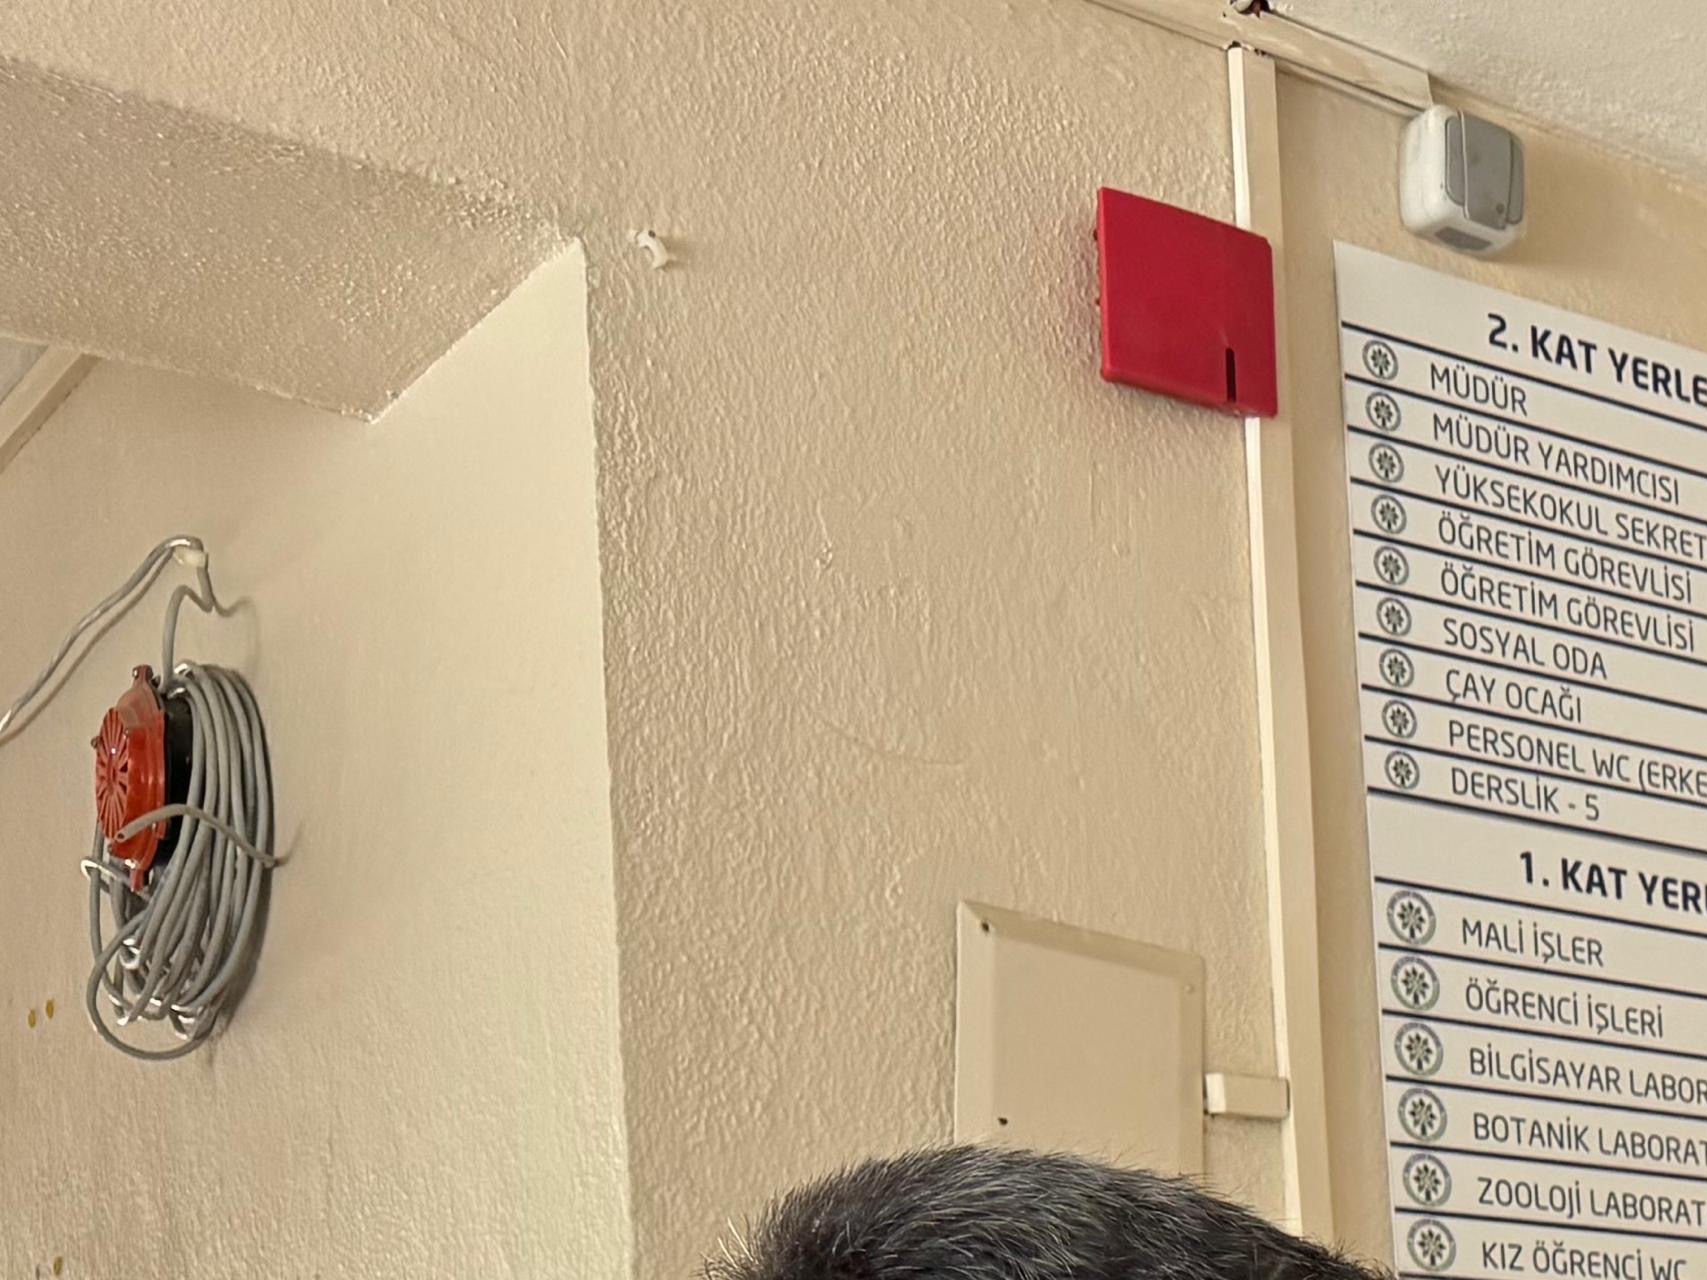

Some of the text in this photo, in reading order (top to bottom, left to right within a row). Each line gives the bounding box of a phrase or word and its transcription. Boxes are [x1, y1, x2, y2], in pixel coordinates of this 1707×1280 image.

[1488, 313, 1518, 352] 2.
[1531, 325, 1597, 374] KAT
[1430, 362, 1526, 415] MÜDÜR
[1433, 415, 1679, 505] MÜDÜR YARDIMCISI
[1435, 466, 1609, 536] YÜKSEKOKUL
[1438, 511, 1691, 603] ÖĞRETİM GÖREVLİSİ
[1441, 561, 1694, 651] ÖĞRETİM GÖREVLİSİ
[1443, 619, 1607, 679] SOSYAL ODA
[1446, 669, 1581, 723] ÇAY OCAĞI
[1449, 720, 1585, 772] PERSONEL
[1593, 750, 1629, 782] WC
[1452, 767, 1558, 813] DERSLİK
[1586, 794, 1599, 820] 5
[1520, 851, 1549, 887] 1.
[1561, 858, 1627, 900] KAT
[1462, 918, 1603, 966] MALİ İŞLER
[1466, 978, 1664, 1038] ÖĞRENCİ İŞLERİ
[1470, 1043, 1621, 1093] BİLGİSAYAR
[1473, 1112, 1589, 1151] BOTANİK
[1477, 1177, 1580, 1218] ZOOLOJİ
[1482, 1242, 1523, 1271] KIZ
[1533, 1241, 1642, 1280] ÖĞRENCİ
